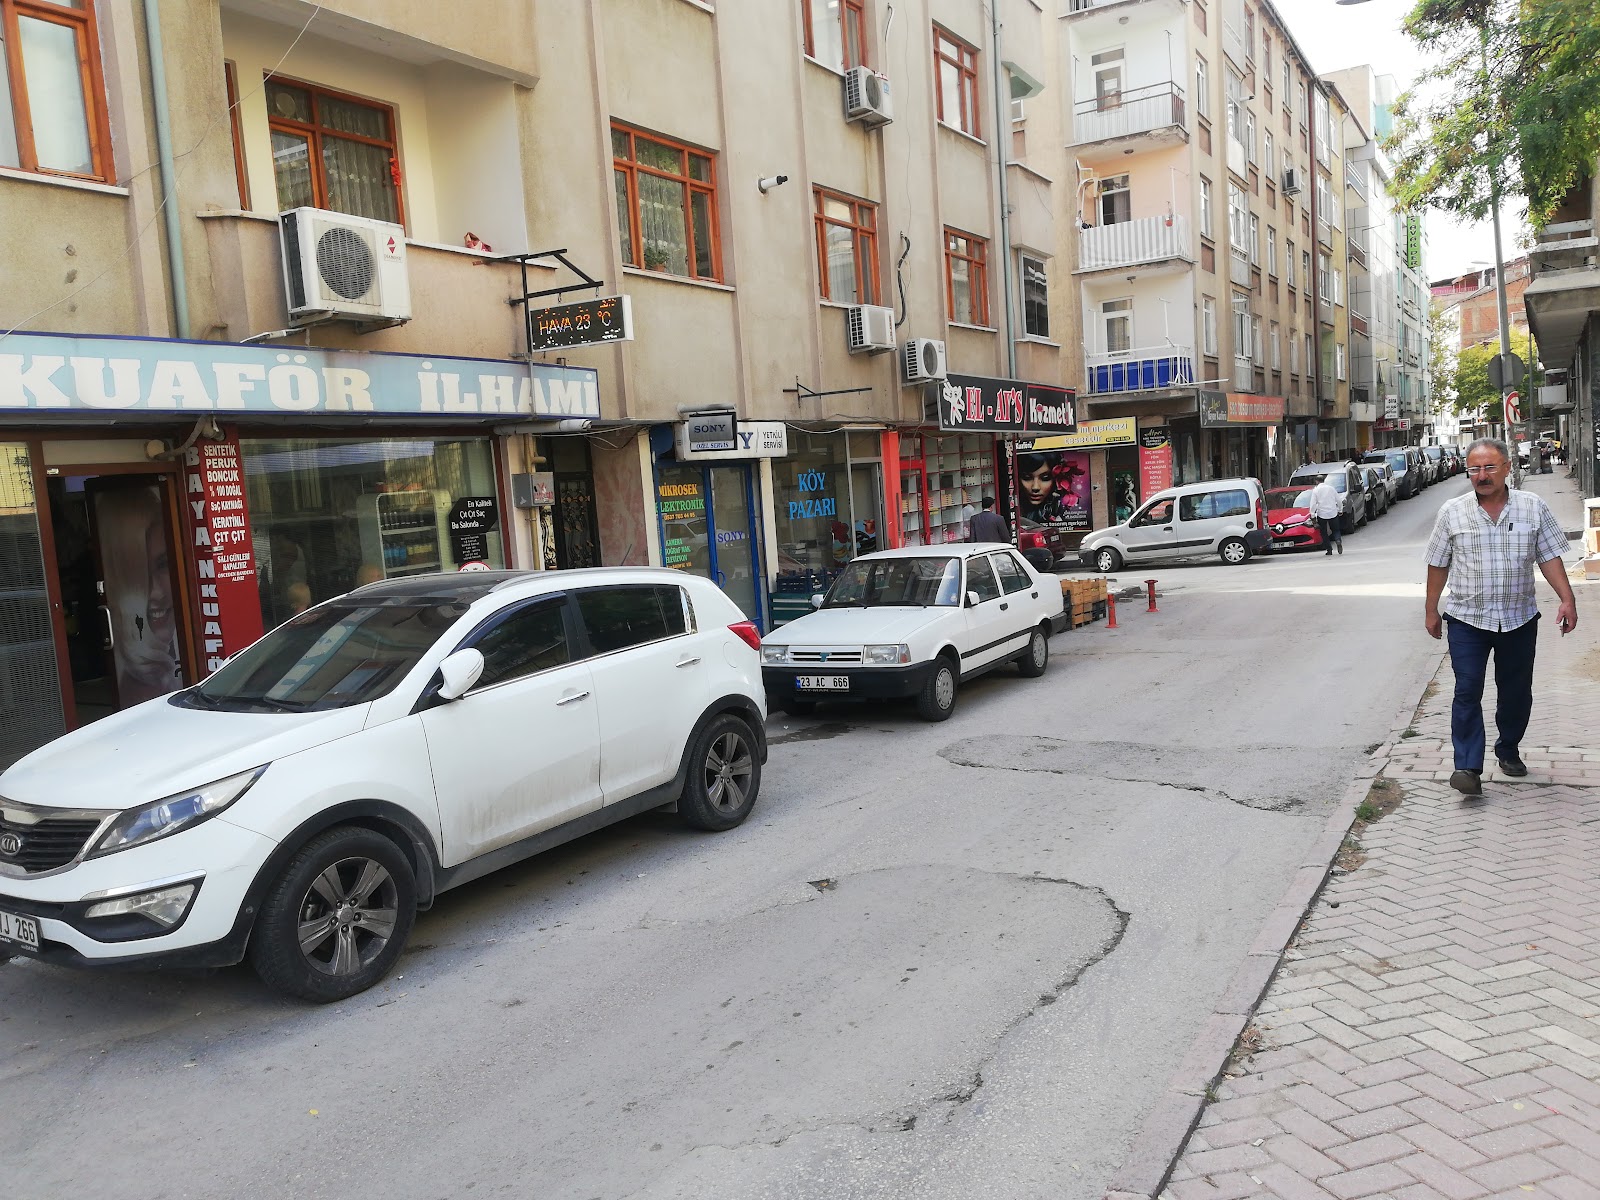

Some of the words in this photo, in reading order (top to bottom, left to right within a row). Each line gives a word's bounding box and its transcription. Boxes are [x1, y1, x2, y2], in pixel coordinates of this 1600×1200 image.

[539, 316, 573, 336] HAVA
[575, 313, 591, 331] 23
[0, 353, 374, 412] KUAFÖR
[417, 361, 600, 417] İLHAMİ
[965, 386, 984, 423] EL
[693, 424, 726, 434] SONY
[204, 443, 237, 457] SENTETİK
[206, 457, 238, 469] PERUK
[206, 470, 240, 483] BONCUK
[797, 468, 826, 492] KÖY
[226, 483, 243, 496] DOĞAL
[467, 500, 475, 508] En
[788, 497, 836, 520] PAZARI
[212, 513, 246, 529] KERATİNLİ
[214, 531, 230, 546] ÇIT
[231, 529, 246, 545] ÇIT
[717, 531, 744, 542] SONY
[800, 677, 811, 687] 23
[815, 677, 826, 688] AC
[832, 677, 848, 688] 666
[1, 837, 16, 851] KIA
[15, 917, 36, 943] 266
